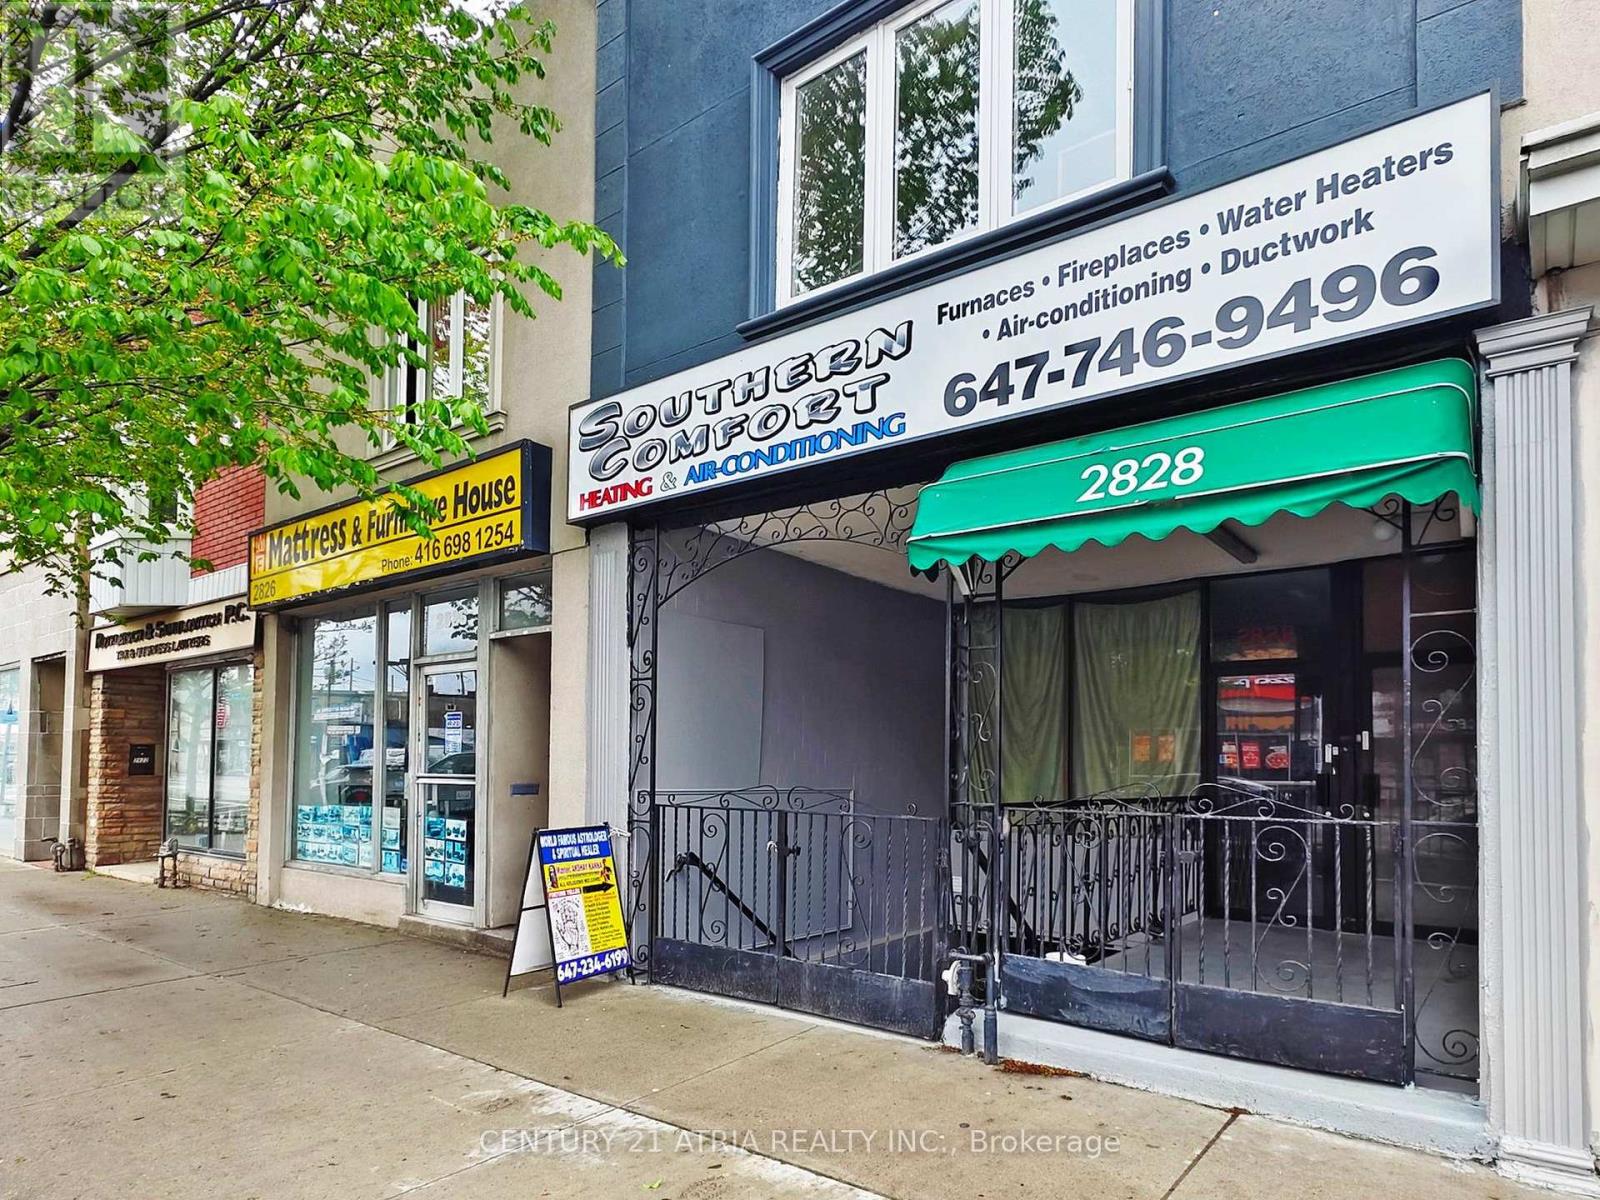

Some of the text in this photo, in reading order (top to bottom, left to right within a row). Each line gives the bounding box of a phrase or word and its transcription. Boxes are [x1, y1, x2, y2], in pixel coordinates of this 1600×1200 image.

[937, 142, 1454, 325] Furnaces Fireplaces Water Heaters
[997, 207, 1375, 341] Air-conditioning Ductwork
[943, 245, 1440, 418] 647-746-9496
[579, 320, 914, 450] SOUTHERN
[588, 372, 891, 481] COMFORT
[579, 412, 906, 511] HEATING & AIR-CONDITIONING
[1075, 446, 1205, 503] 2828
[268, 518, 347, 570] Mattress
[352, 515, 362, 546] &
[453, 475, 516, 519] House
[381, 520, 514, 573] Phone: 416 698 1254
[253, 579, 276, 601] 2826
[540, 830, 608, 848] WORLD FAMOUS ASTROLOGER
[556, 846, 581, 859] SPIRITUAL
[581, 844, 600, 857] HEALER
[557, 949, 628, 982] 647-234-6199
